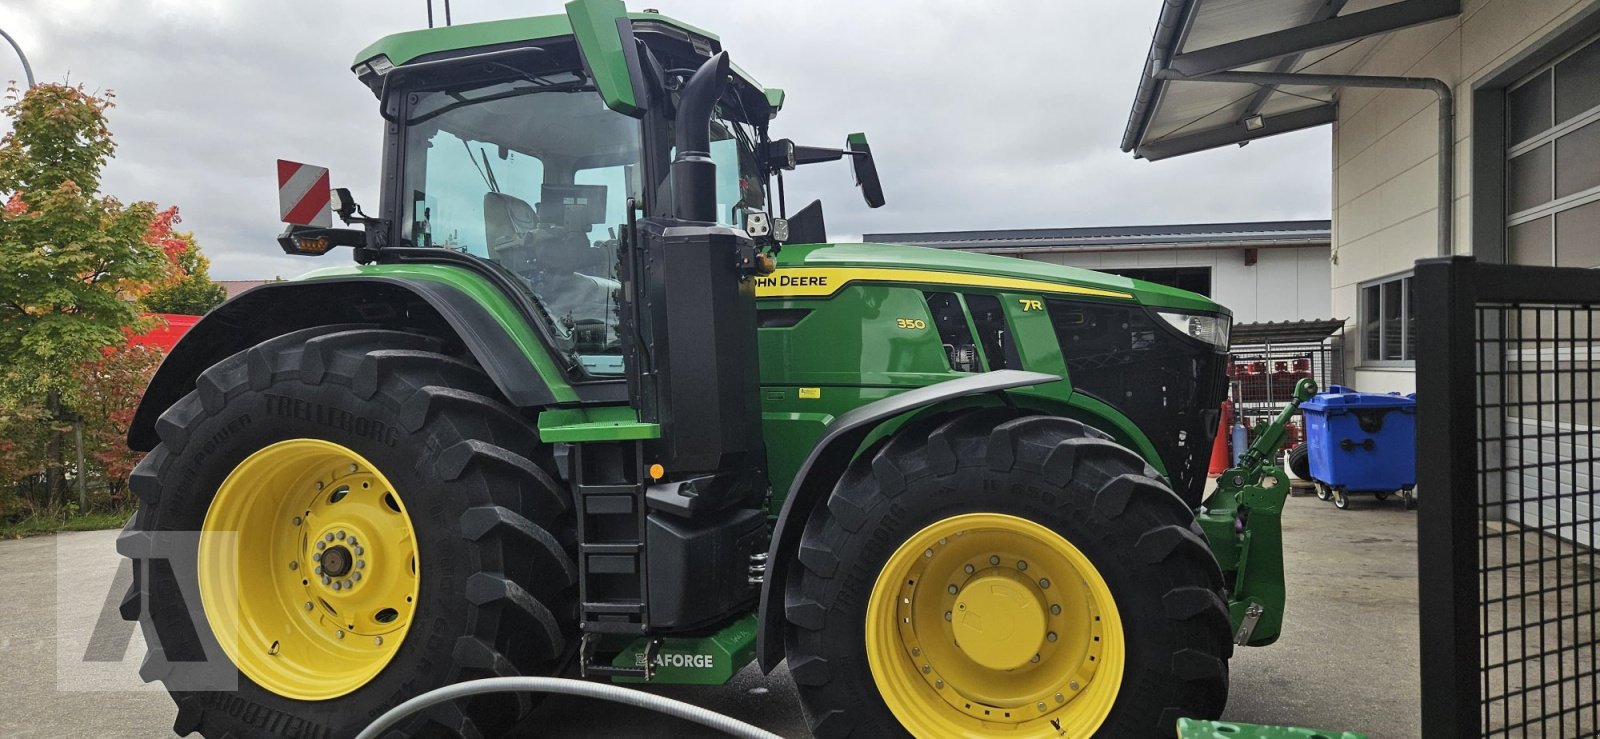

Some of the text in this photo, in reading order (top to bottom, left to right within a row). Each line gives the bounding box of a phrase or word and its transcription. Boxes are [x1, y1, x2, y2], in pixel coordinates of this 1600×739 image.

[780, 275, 828, 287] DEERE
[1019, 298, 1043, 312] 7R
[896, 318, 926, 330] 350
[655, 653, 714, 668] AFORGE
